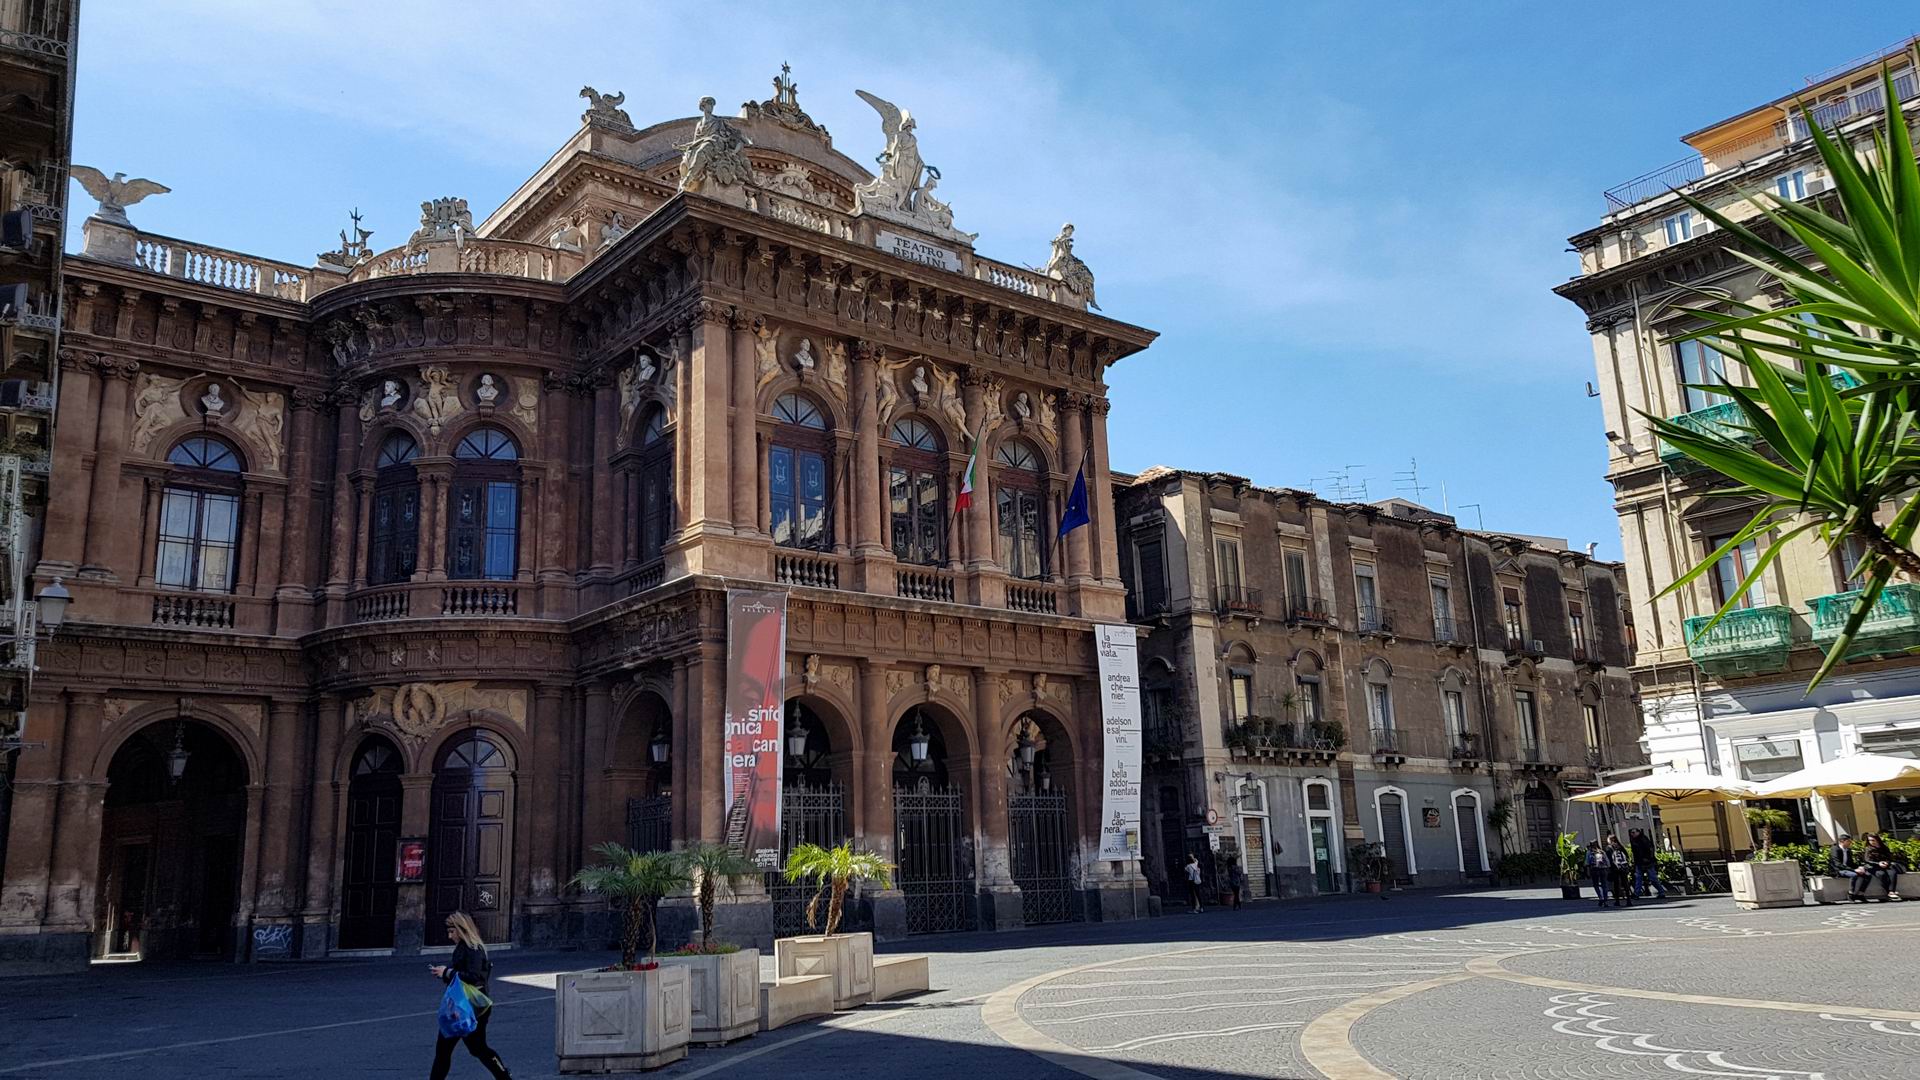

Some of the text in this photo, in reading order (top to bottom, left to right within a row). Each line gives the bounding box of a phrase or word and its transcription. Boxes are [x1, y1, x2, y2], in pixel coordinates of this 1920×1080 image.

[894, 236, 944, 259] TEATRO
[893, 246, 946, 269] BELLINI
[1108, 673, 1131, 682] andrea
[1111, 682, 1123, 691] che
[1106, 716, 1132, 725] adelson
[1117, 760, 1124, 769] la
[1111, 769, 1128, 779] bella
[1113, 810, 1121, 819] la
